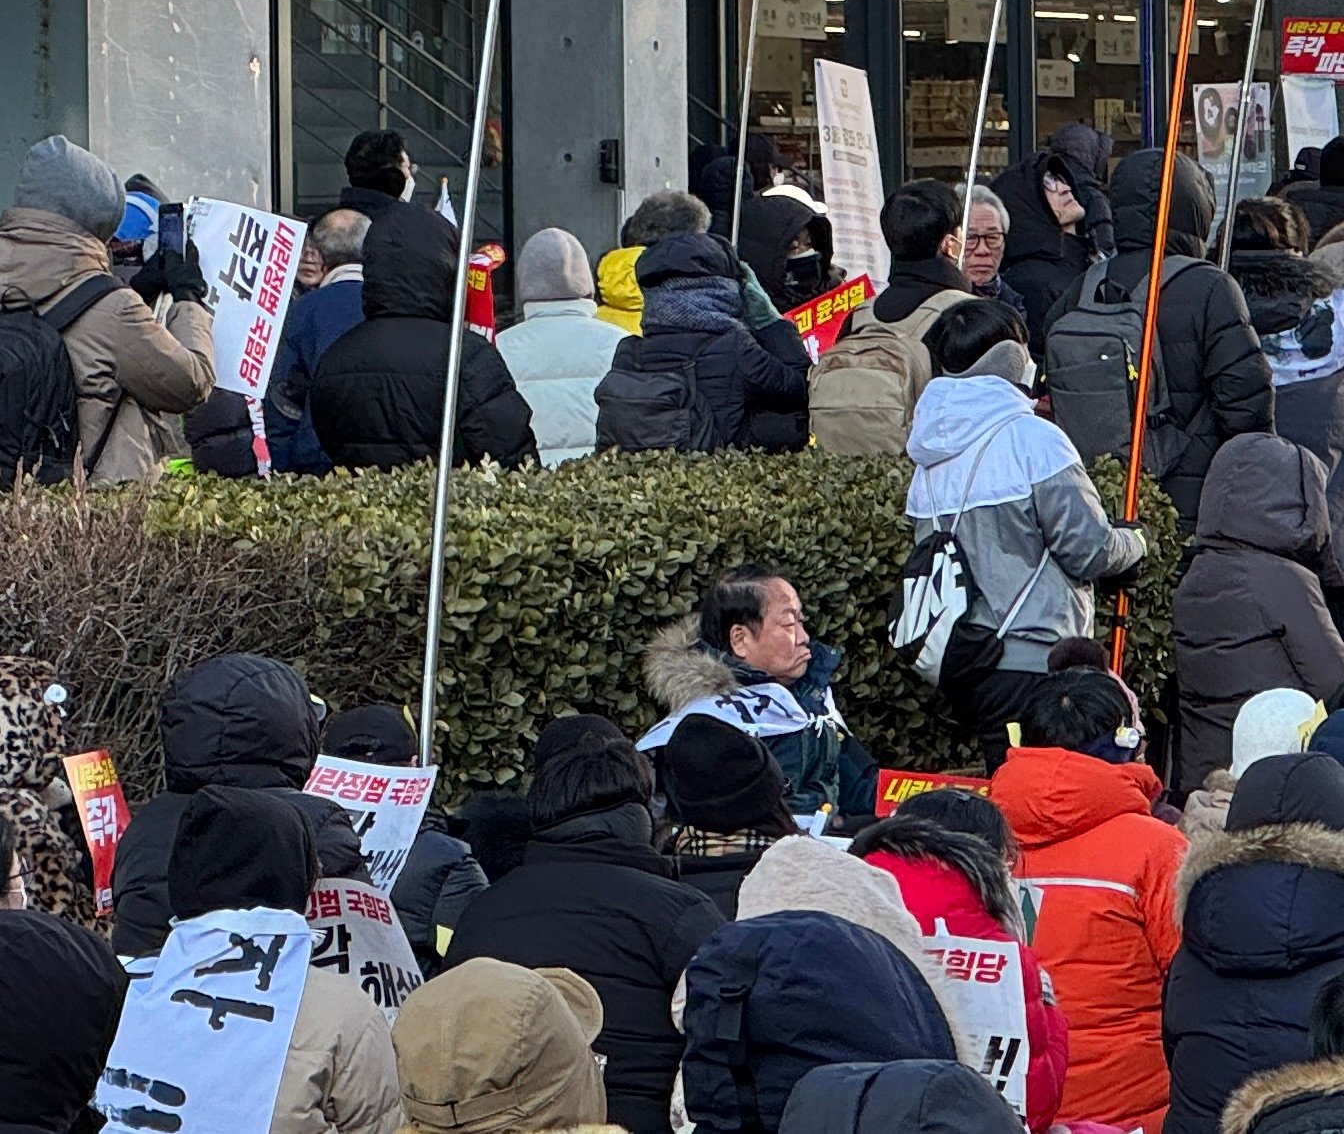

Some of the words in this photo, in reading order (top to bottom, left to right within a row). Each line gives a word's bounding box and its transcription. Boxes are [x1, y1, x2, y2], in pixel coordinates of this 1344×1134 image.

[1284, 35, 1326, 56] 즉각
[218, 211, 269, 303] 즉각
[257, 220, 297, 317] 내란정범
[816, 281, 866, 326] 윤석열
[238, 315, 274, 389] 국힘당
[85, 793, 119, 847] 즉각
